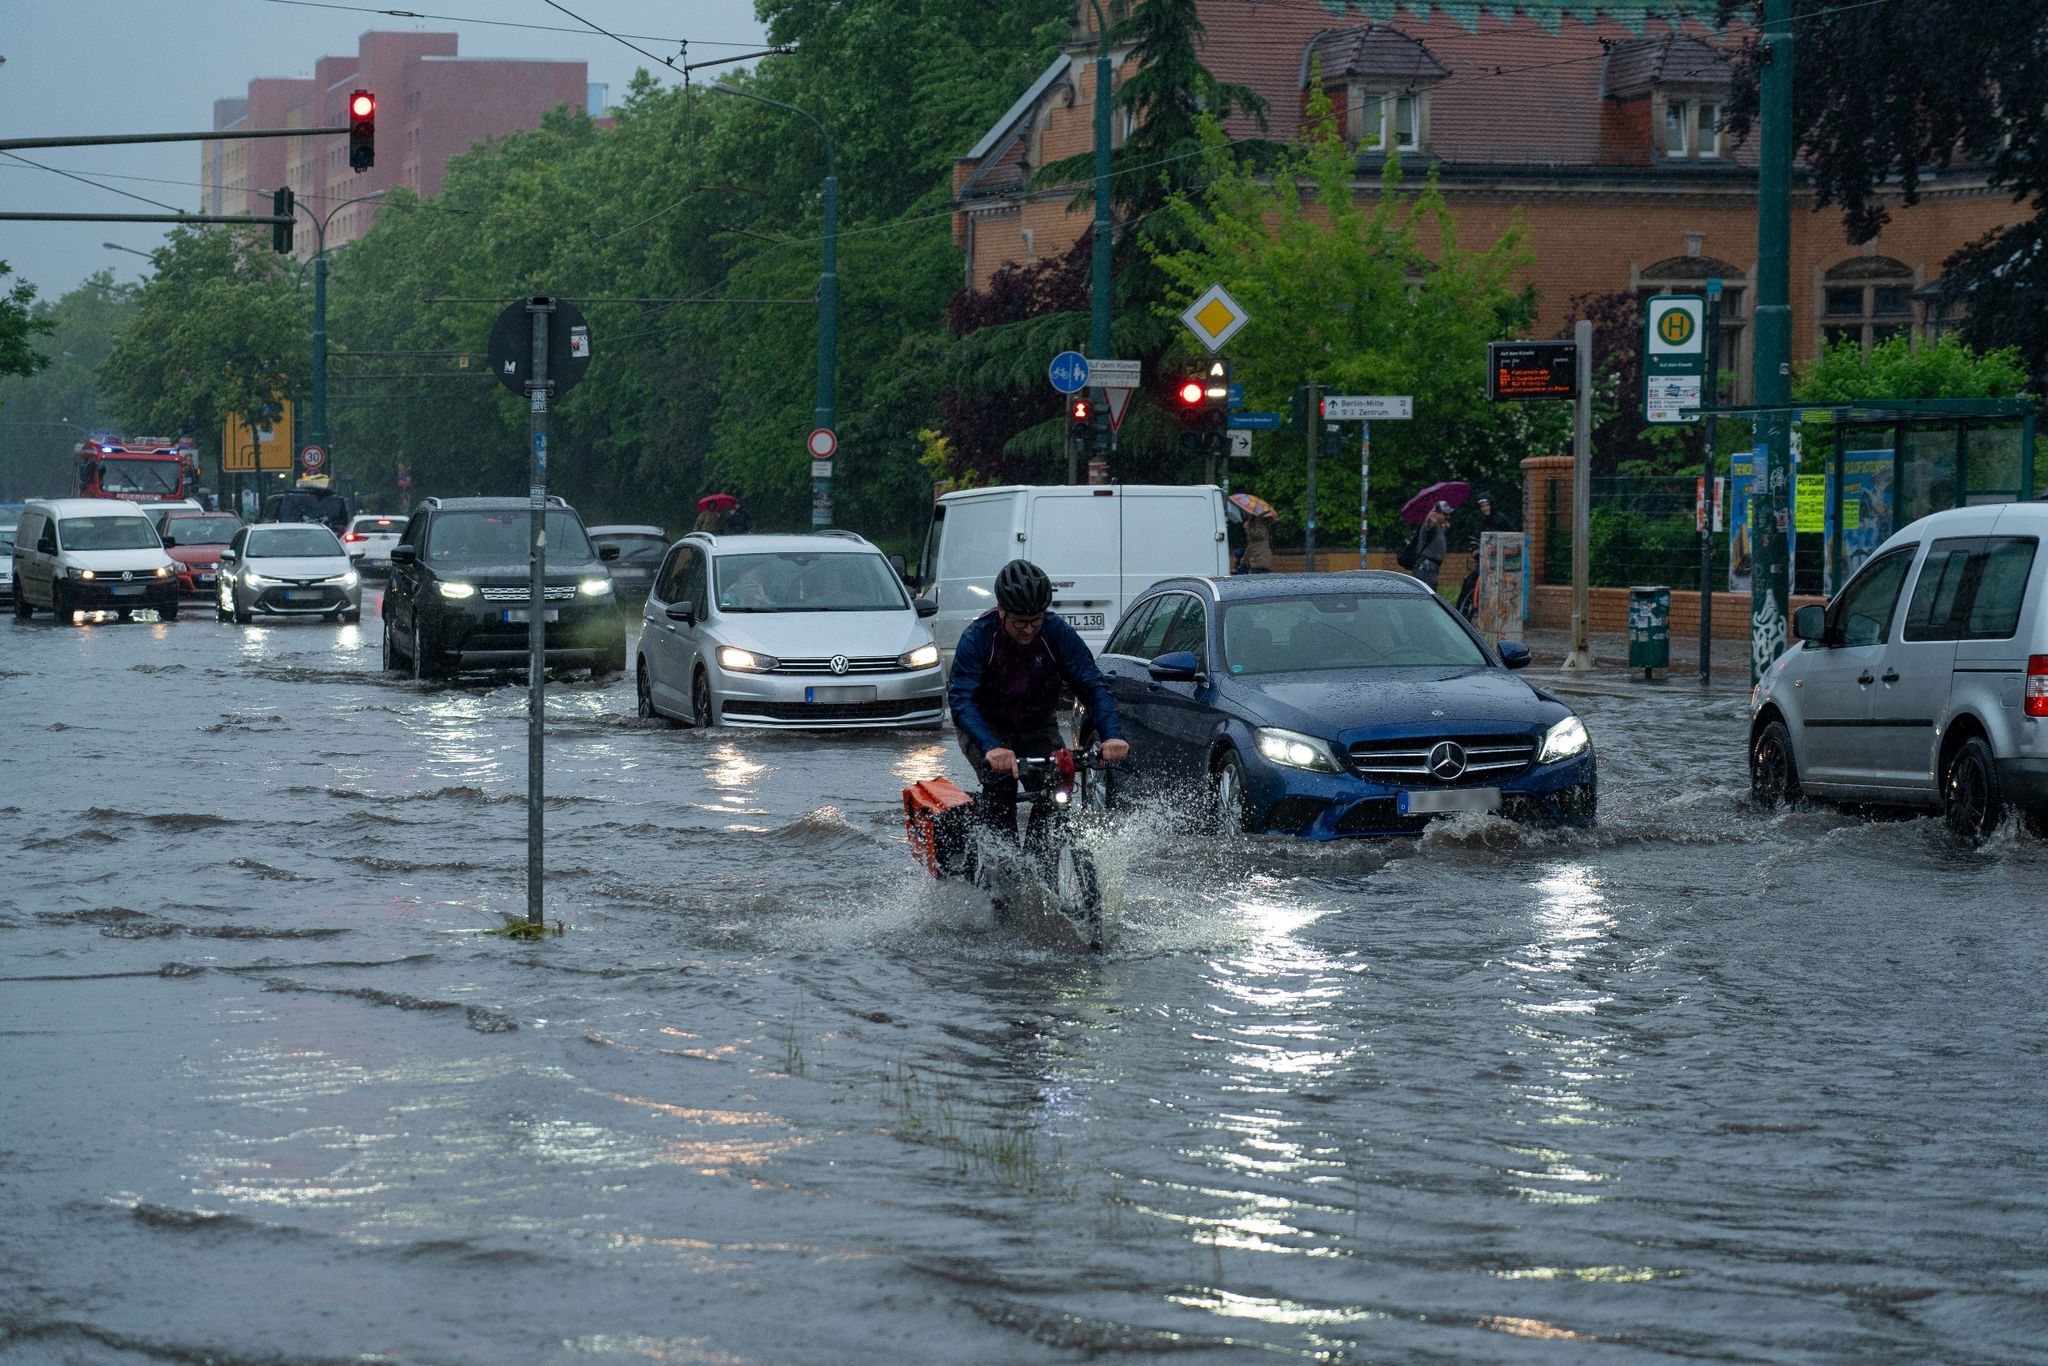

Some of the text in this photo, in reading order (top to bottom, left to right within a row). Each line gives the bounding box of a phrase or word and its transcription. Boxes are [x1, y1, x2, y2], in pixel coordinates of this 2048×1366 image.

[1669, 316, 1684, 337] H
[306, 452, 320, 462] 30
[1083, 615, 1102, 626] 130
